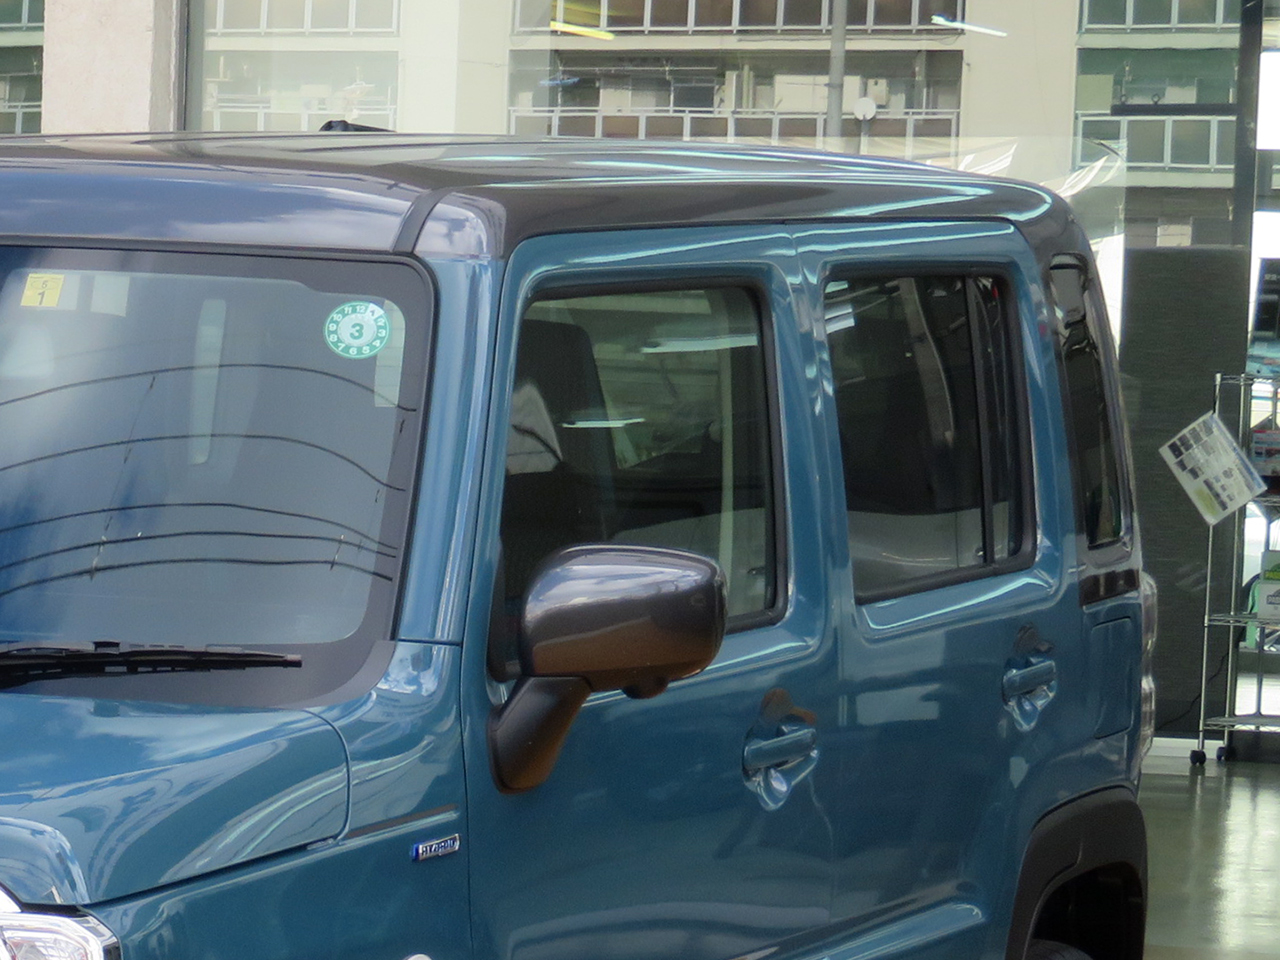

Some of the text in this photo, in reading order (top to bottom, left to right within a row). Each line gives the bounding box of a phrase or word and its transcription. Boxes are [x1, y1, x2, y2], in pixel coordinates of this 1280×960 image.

[344, 306, 352, 314] 11
[356, 305, 366, 314] 12
[369, 309, 376, 317] 1
[332, 313, 342, 322] 10
[377, 318, 385, 326] 2
[328, 323, 337, 331] 9
[349, 323, 365, 340] 3
[377, 329, 386, 337] 3
[329, 334, 338, 342] 8
[337, 342, 346, 350] 7
[372, 339, 380, 347] 4
[349, 347, 357, 355] 6
[362, 346, 370, 354] 5
